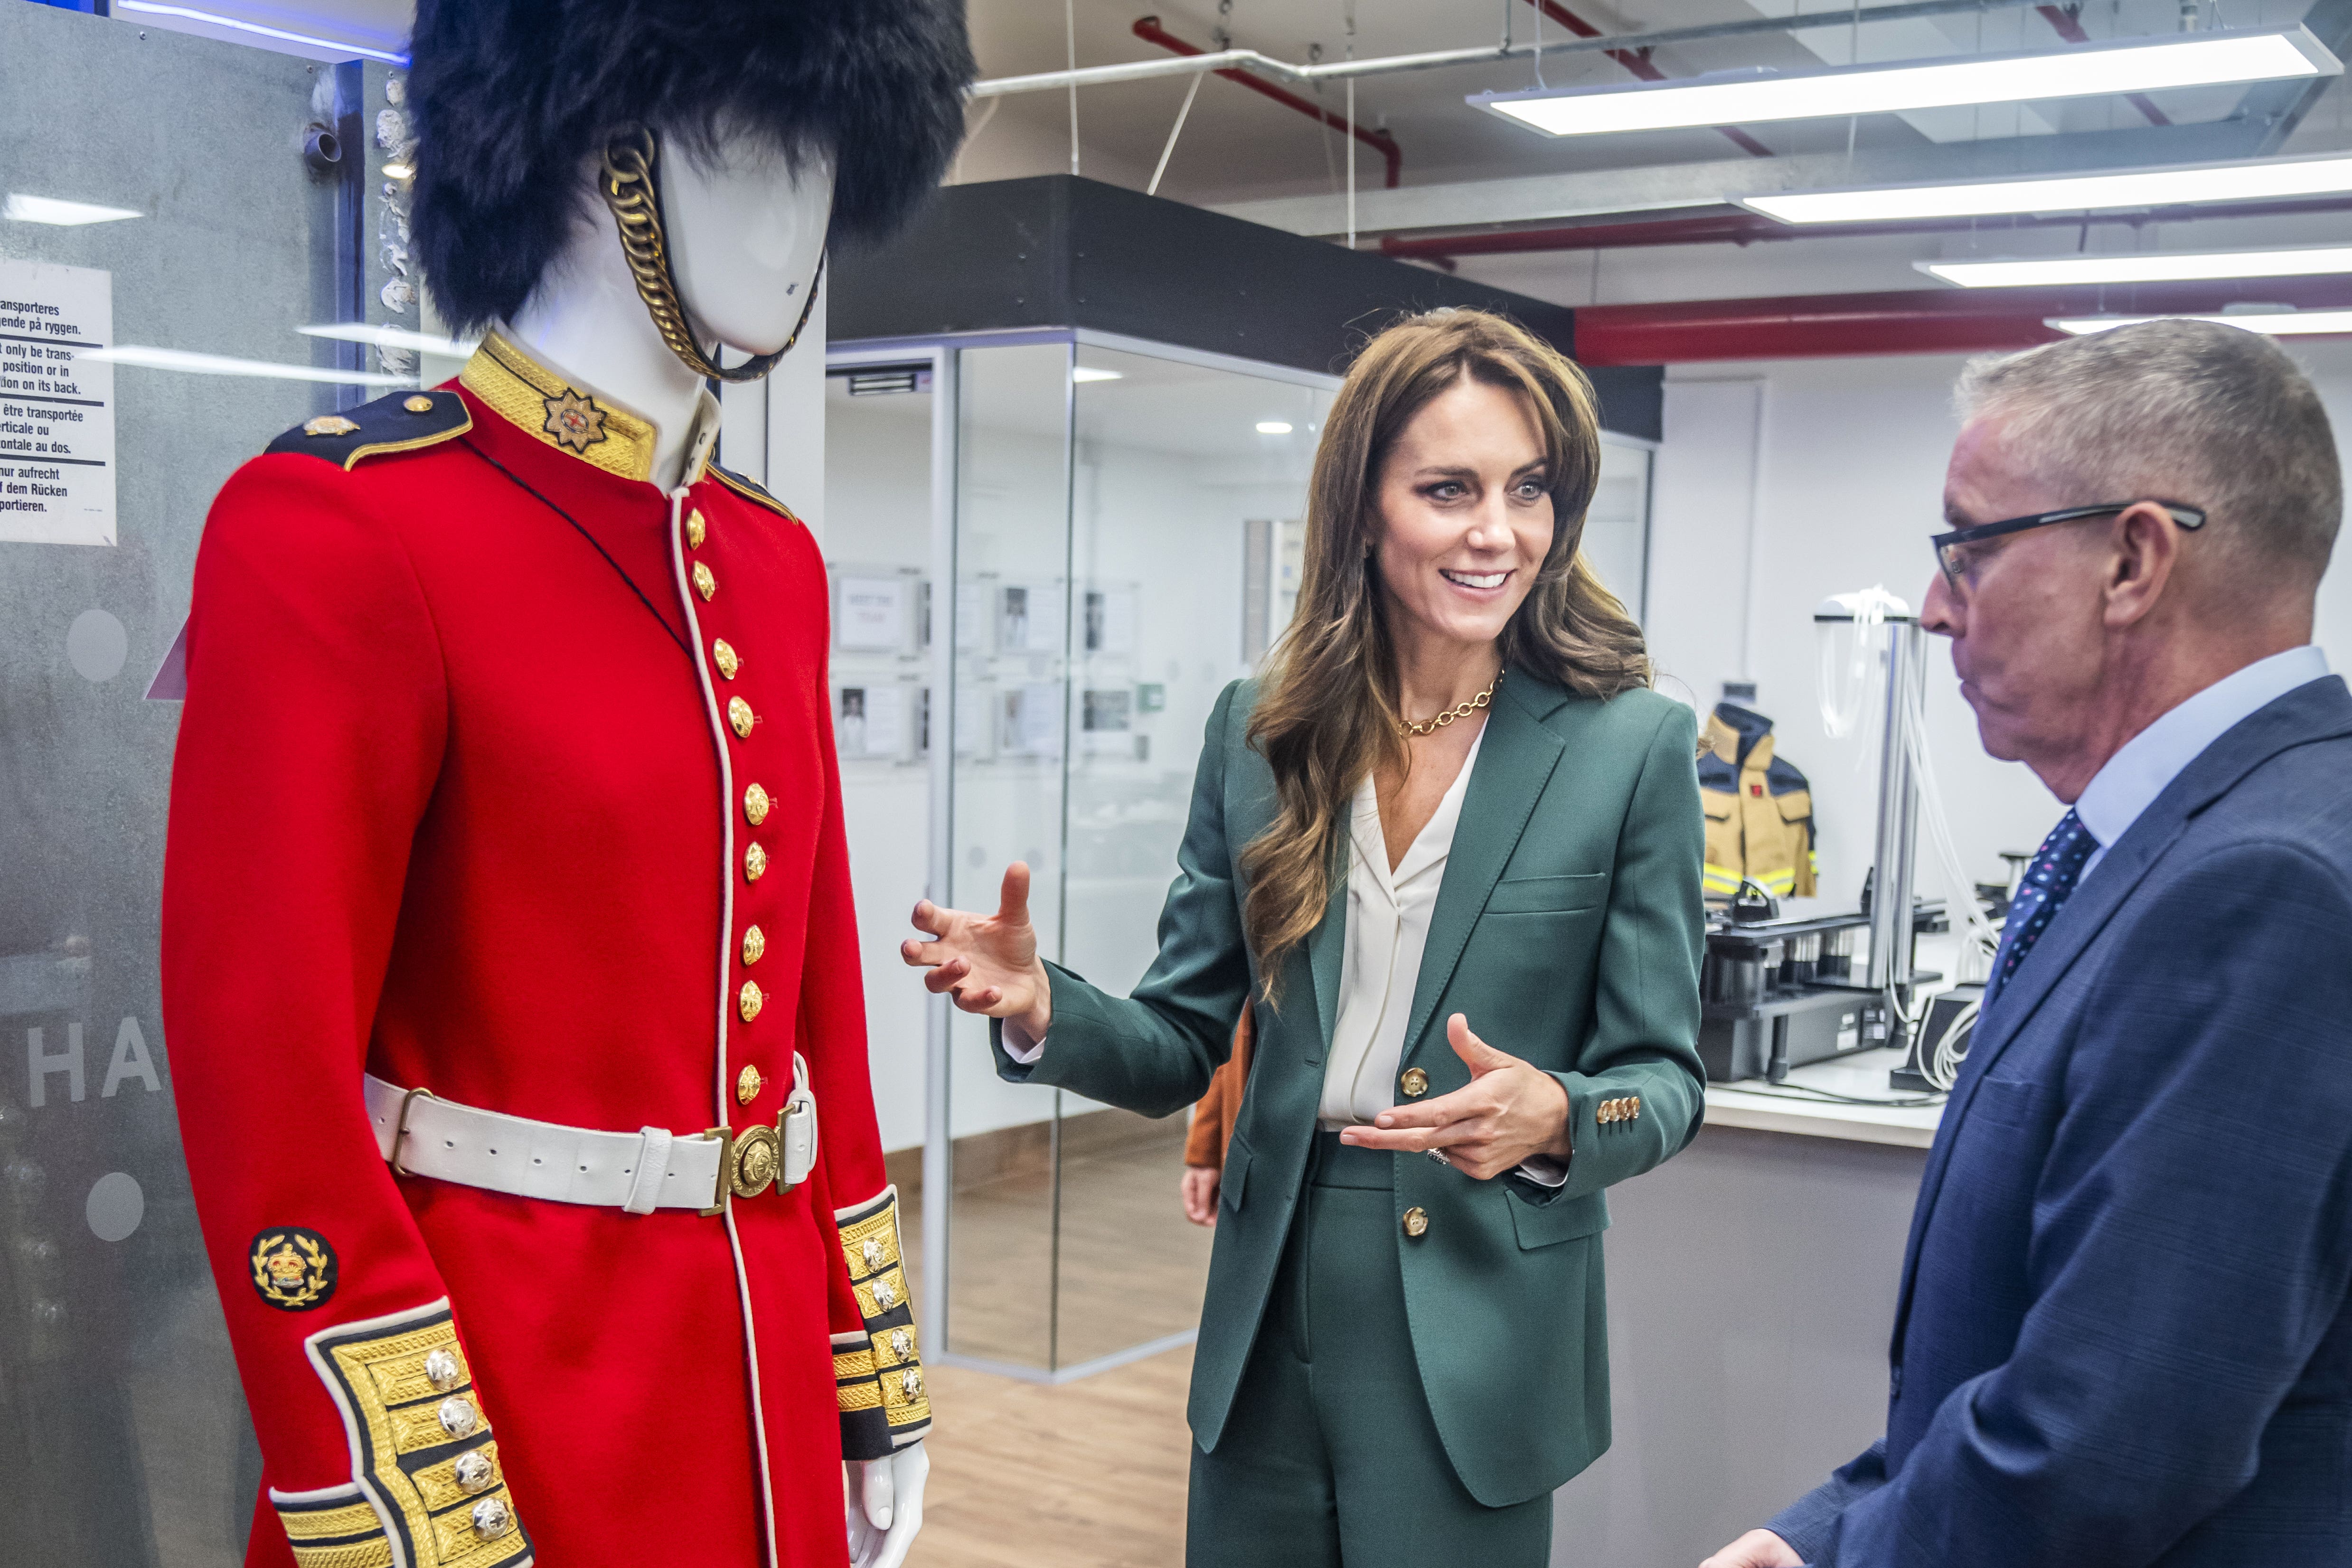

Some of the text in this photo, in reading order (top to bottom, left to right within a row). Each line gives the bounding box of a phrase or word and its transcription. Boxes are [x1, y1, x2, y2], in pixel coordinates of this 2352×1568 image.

[0, 300, 59, 316] ansporteres
[0, 316, 81, 335] ende på ryggen.
[6, 344, 27, 358] only
[30, 345, 42, 357] be
[46, 347, 74, 361] trans-
[3, 361, 69, 377] position or in
[22, 380, 35, 390] on
[38, 379, 51, 392] its
[54, 381, 81, 394] back.
[3, 404, 83, 423] être transportée
[37, 426, 49, 436] ou
[36, 442, 47, 452] au
[51, 441, 71, 454] dos.
[0, 467, 60, 480] nur aufrecht
[7, 482, 28, 495] dem
[31, 483, 67, 497] Rücken
[0, 499, 47, 512] portieren.
